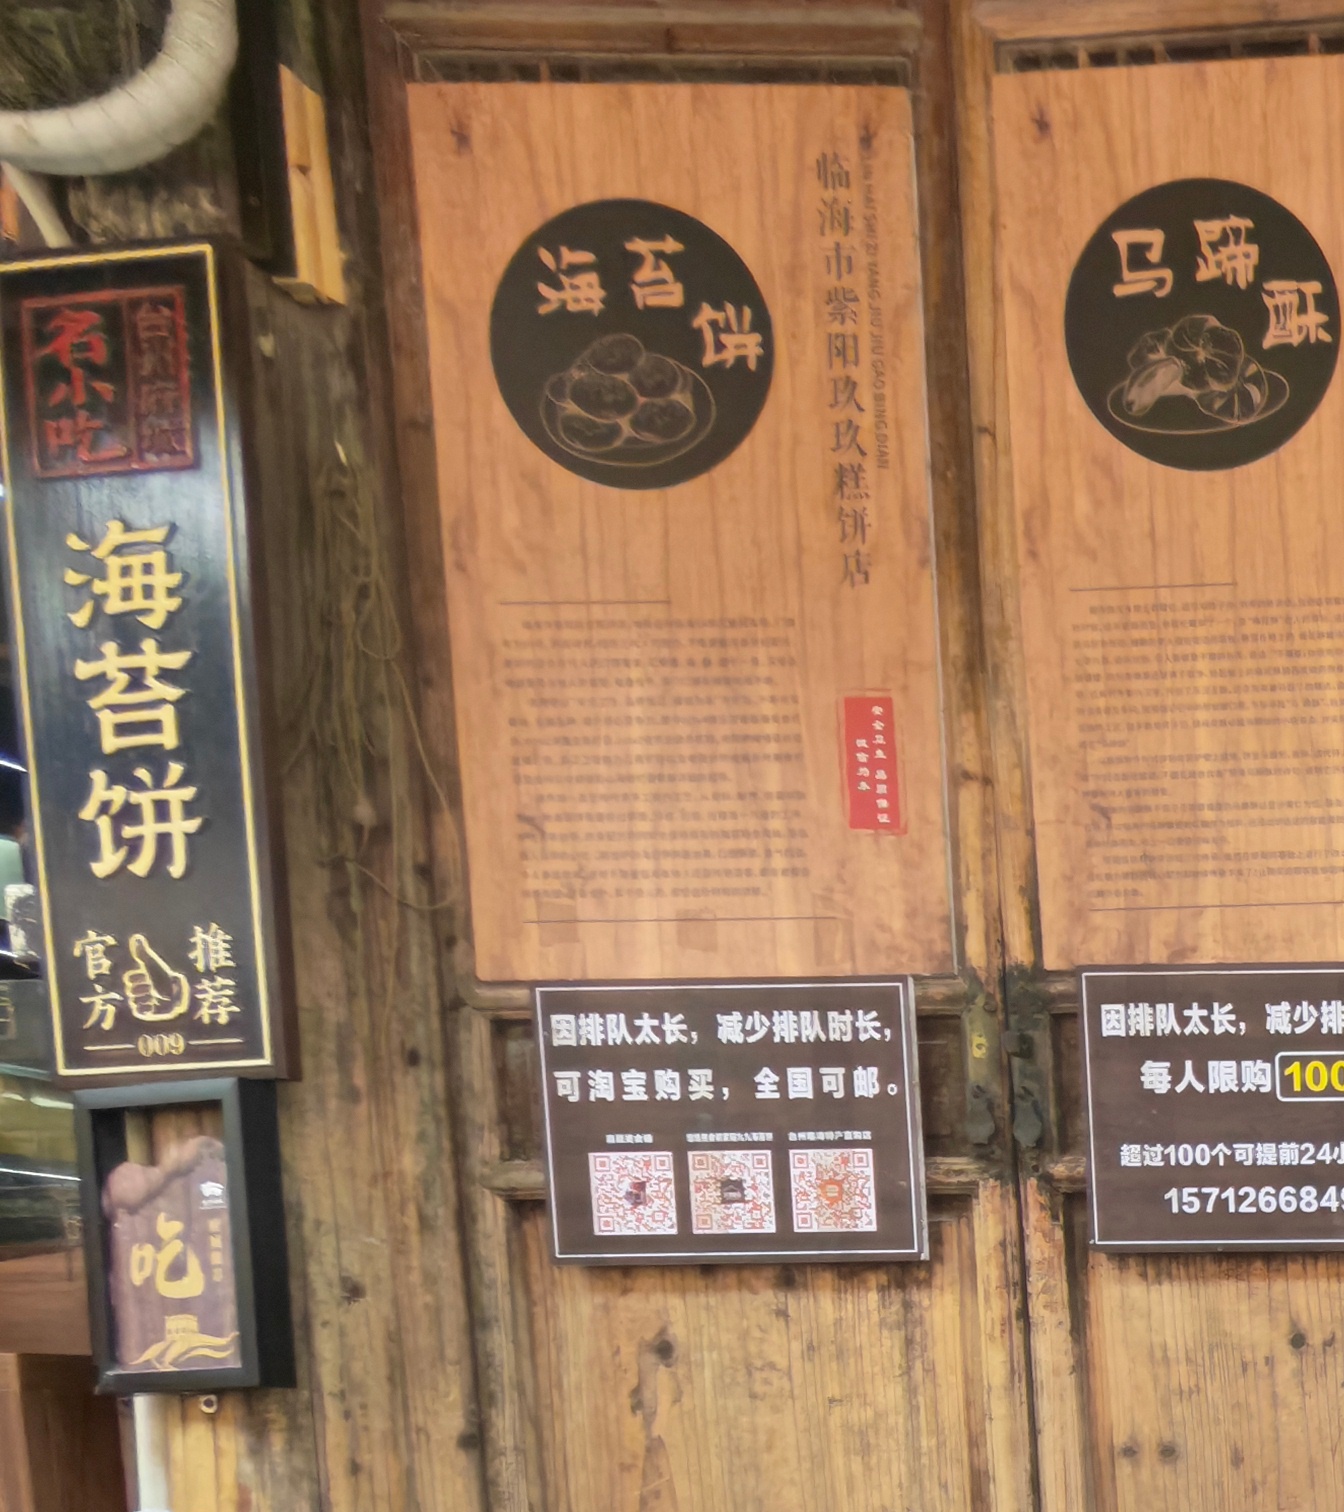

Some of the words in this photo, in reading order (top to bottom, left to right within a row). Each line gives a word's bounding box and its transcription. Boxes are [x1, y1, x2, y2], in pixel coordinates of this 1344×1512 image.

[536, 234, 764, 372] 海苔饼
[1111, 214, 1333, 349] 马蹄酥
[814, 151, 874, 588] 临海市紫阳玖玖糕饼店
[872, 360, 886, 389] GAO
[874, 392, 888, 430] BING
[875, 433, 890, 469] DIAN
[63, 520, 203, 880] 海苔饼
[71, 929, 124, 1032] 官方
[188, 921, 242, 1027] 推荐
[137, 1032, 186, 1057] 009
[1139, 1060, 1272, 1094] 每人限购
[130, 1211, 206, 1299] 吃
